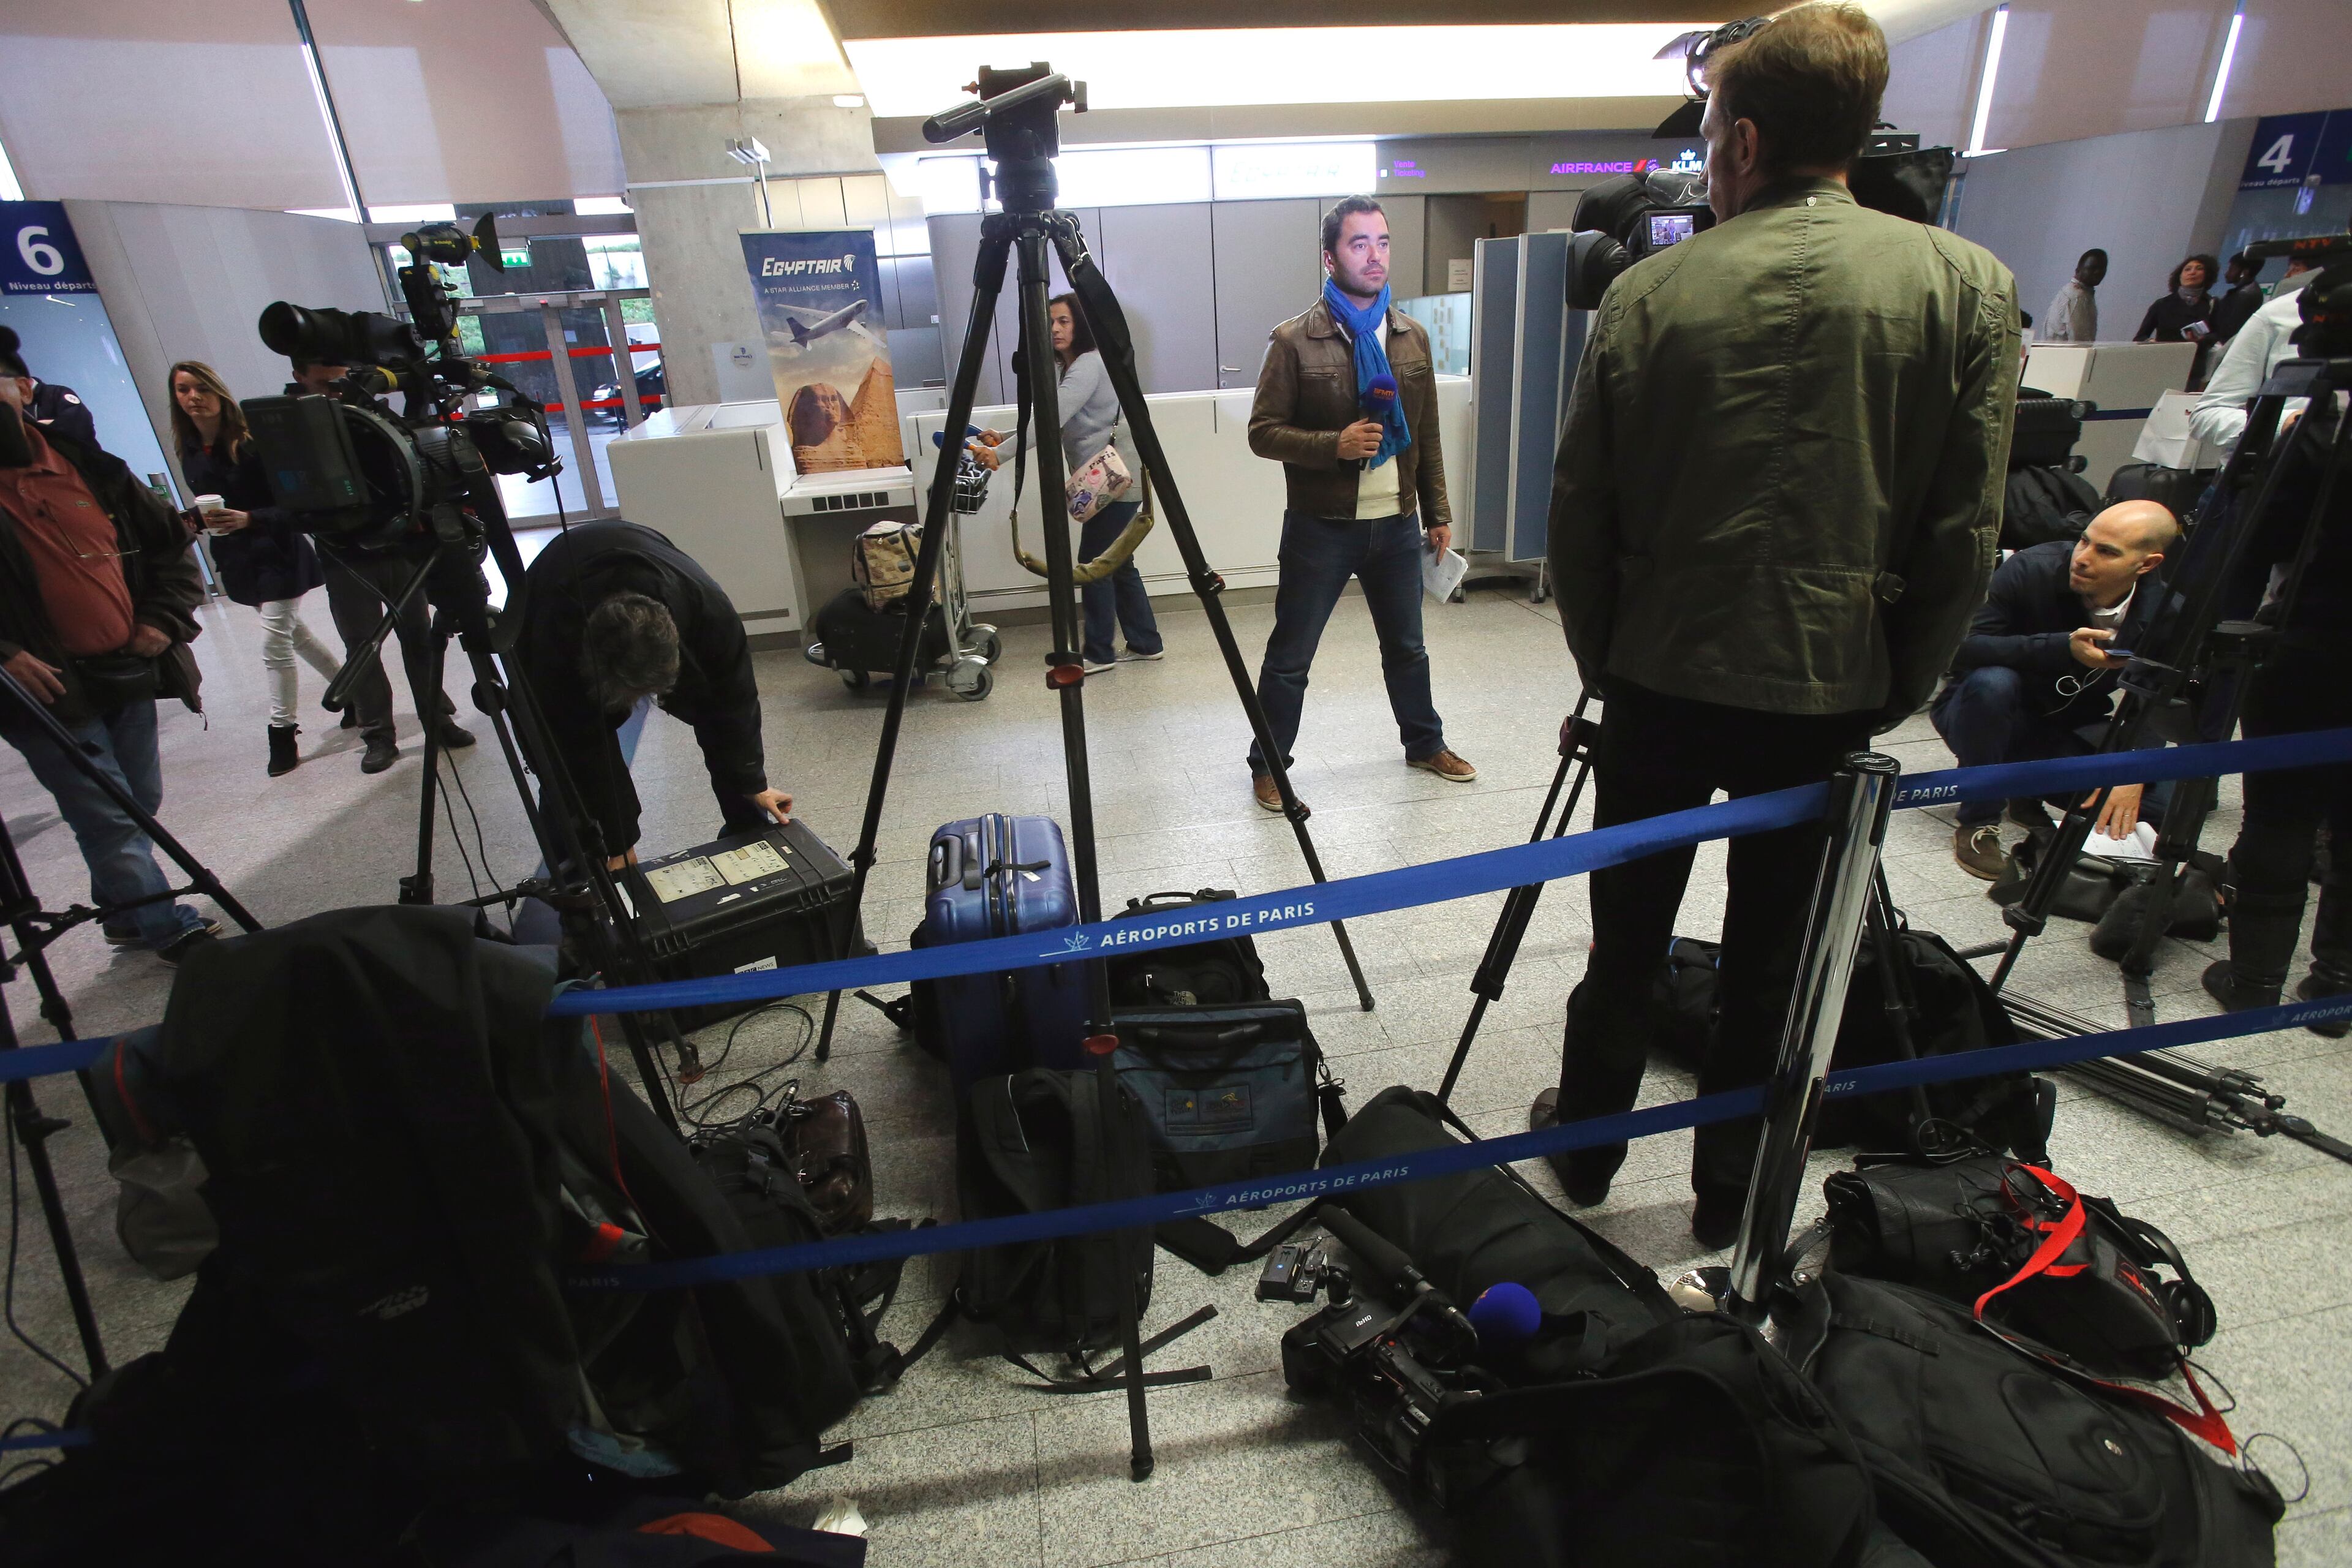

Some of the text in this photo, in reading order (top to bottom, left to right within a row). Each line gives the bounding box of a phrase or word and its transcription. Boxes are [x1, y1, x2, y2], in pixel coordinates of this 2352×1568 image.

[2257, 134, 2294, 173] 4
[1550, 162, 1633, 174] AIRFRANCE
[1672, 160, 1703, 172] KLM
[1394, 169, 1425, 178] Ticketing
[17, 225, 65, 276] 6
[761, 257, 842, 277] EGYPTAIR
[9, 282, 51, 291] Niveau
[788, 284, 820, 293] ALLIANCE
[1911, 785, 1958, 801] PARIS
[1101, 902, 1315, 948] AÉROPORTS DE PARIS
[1823, 1080, 1857, 1093] ARIS
[1226, 1166, 1409, 1205] AÉROPORTS DE PARIS
